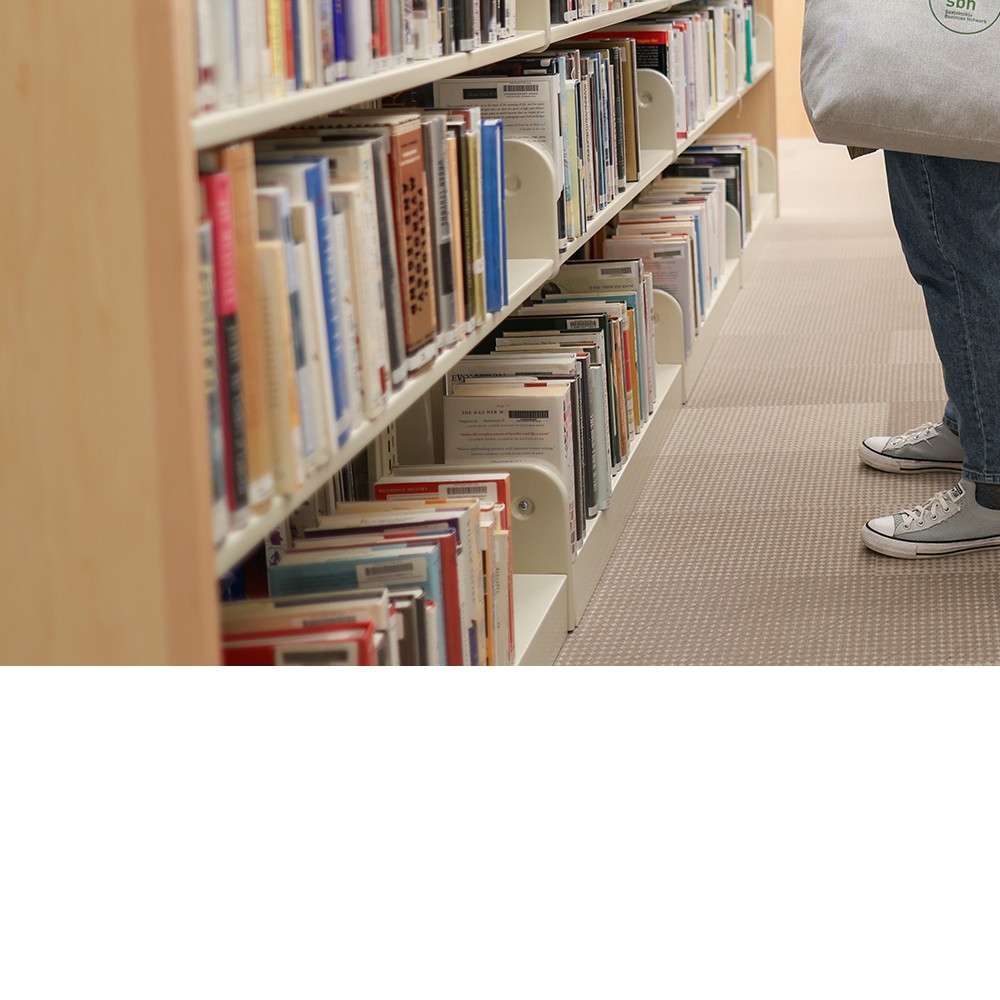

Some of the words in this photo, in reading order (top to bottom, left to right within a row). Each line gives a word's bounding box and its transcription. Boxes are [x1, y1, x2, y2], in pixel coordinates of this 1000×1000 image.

[438, 159, 446, 187] URBAN
[440, 190, 448, 226] LEGENDS
[406, 236, 417, 315] LEGEND
[410, 177, 424, 311] MYTHOLOGY,
[418, 188, 429, 296] FOLKLORE,
